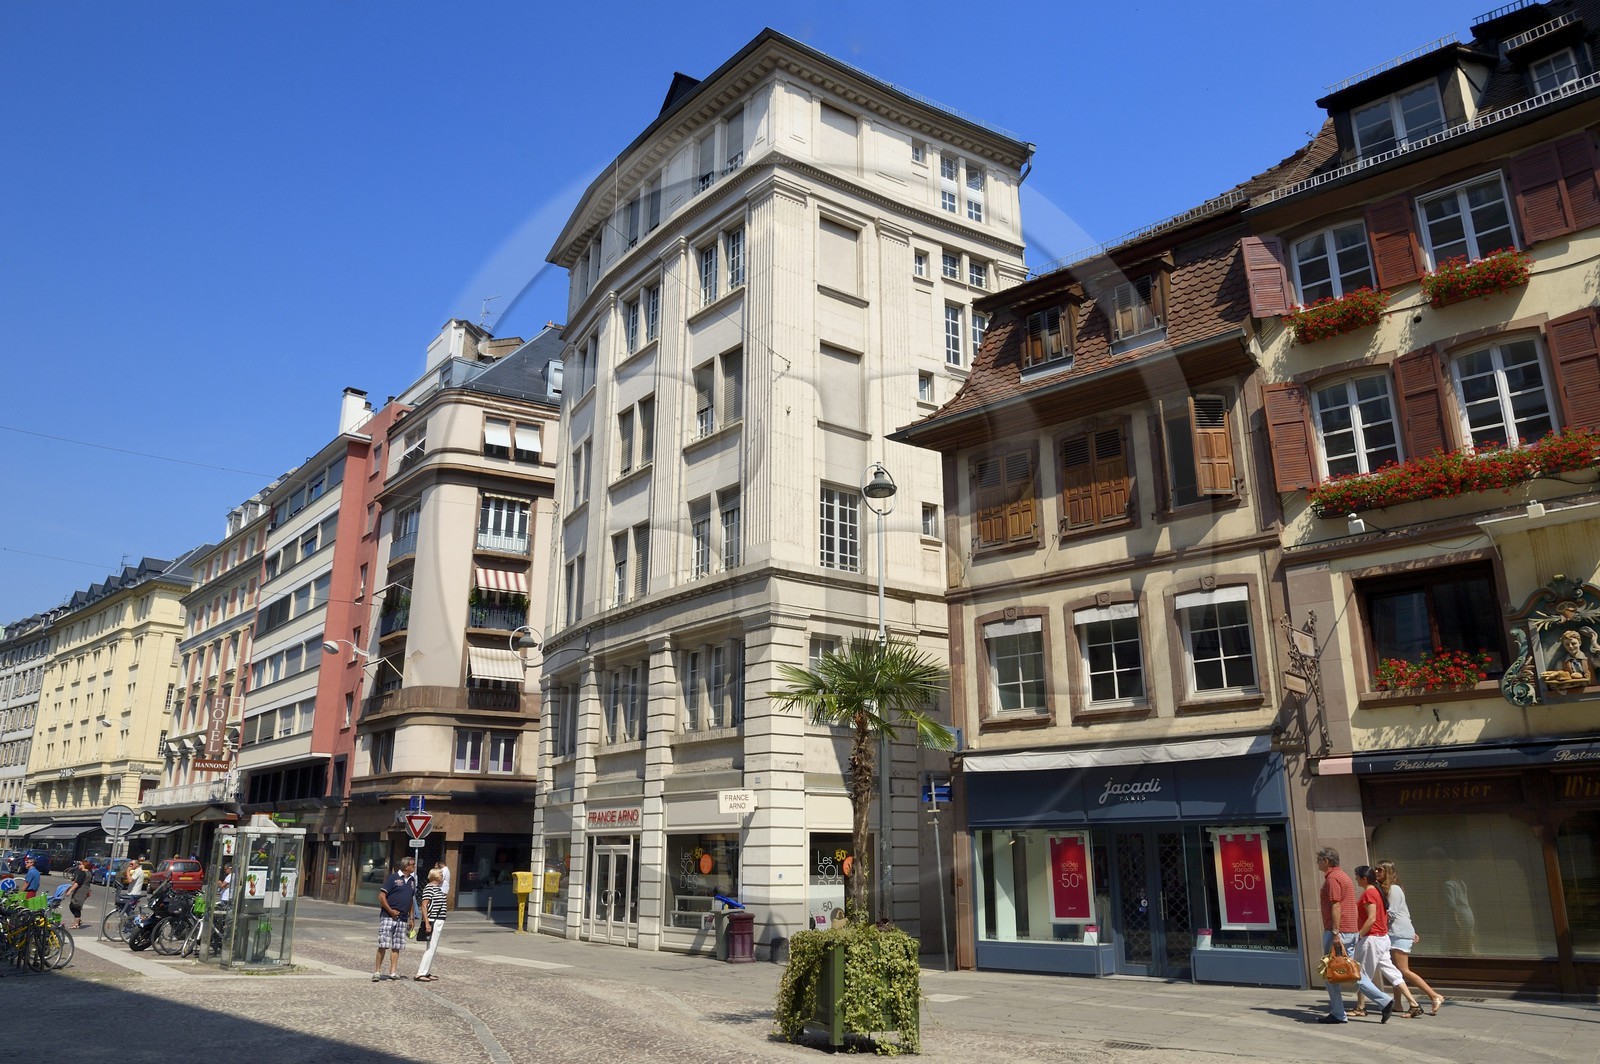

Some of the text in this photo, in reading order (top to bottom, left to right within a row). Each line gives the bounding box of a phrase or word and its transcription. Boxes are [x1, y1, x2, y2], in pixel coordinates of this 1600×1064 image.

[208, 697, 227, 753] HOTEL
[194, 761, 229, 770] HANNONG
[1392, 759, 1450, 771] Patisserie
[723, 793, 750, 802] FRANCE
[1098, 776, 1162, 805] jacadi
[1399, 780, 1492, 805] patissier
[728, 802, 747, 810] ARNO
[587, 808, 640, 824] FRANCE ARNO
[680, 845, 692, 861] Les
[817, 849, 833, 865] Les
[680, 860, 698, 875] SOL
[817, 864, 843, 880] SOL
[679, 874, 698, 889] DES
[1058, 872, 1084, 888] -50%
[1229, 873, 1261, 890] -50%
